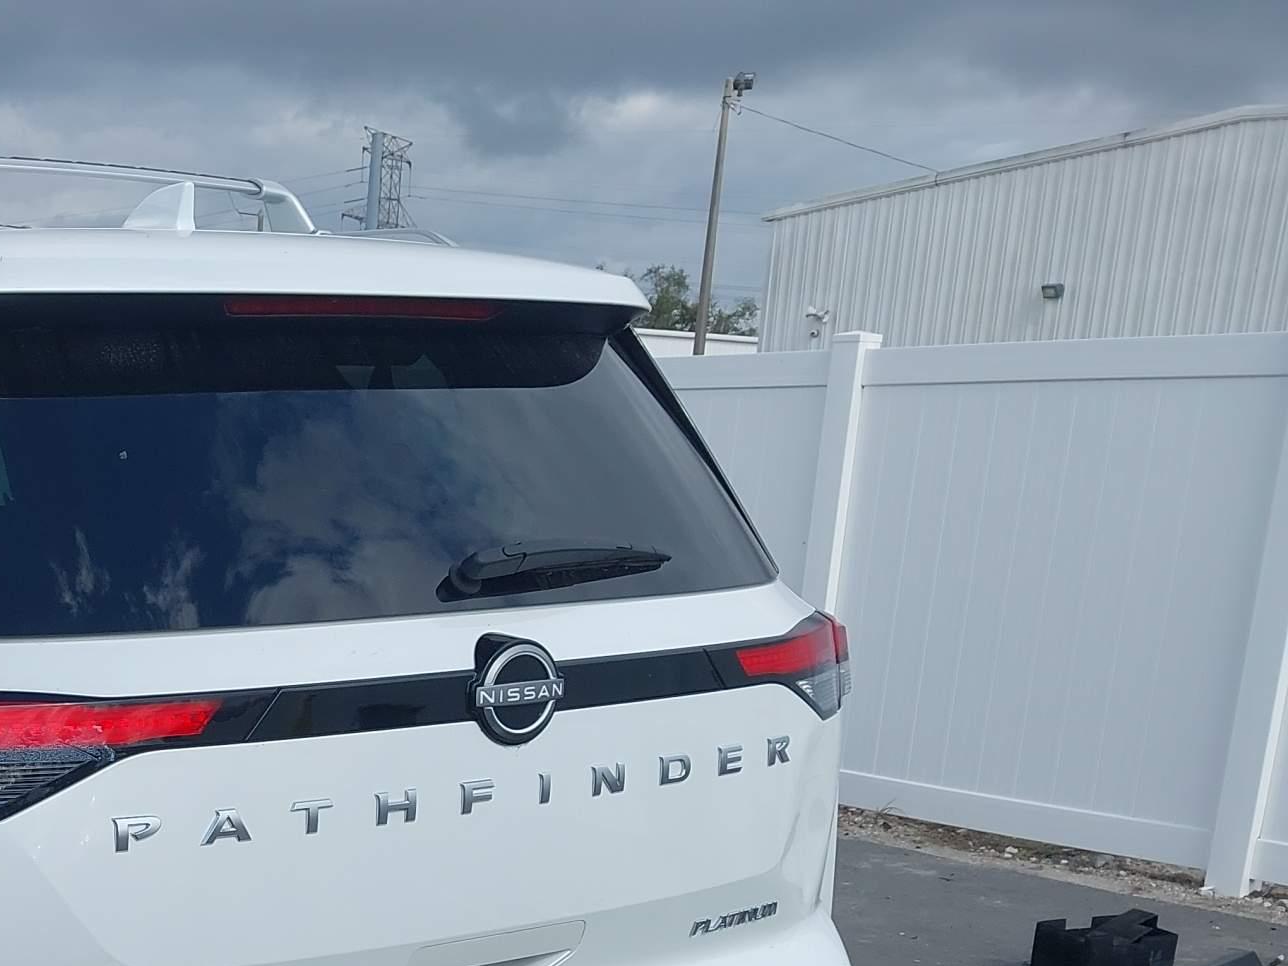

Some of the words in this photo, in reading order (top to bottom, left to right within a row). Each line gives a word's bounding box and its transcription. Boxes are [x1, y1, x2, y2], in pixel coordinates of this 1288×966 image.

[479, 682, 563, 705] NISSAN
[111, 735, 792, 853] PATHFINDER
[689, 901, 778, 937] PLATINUM
